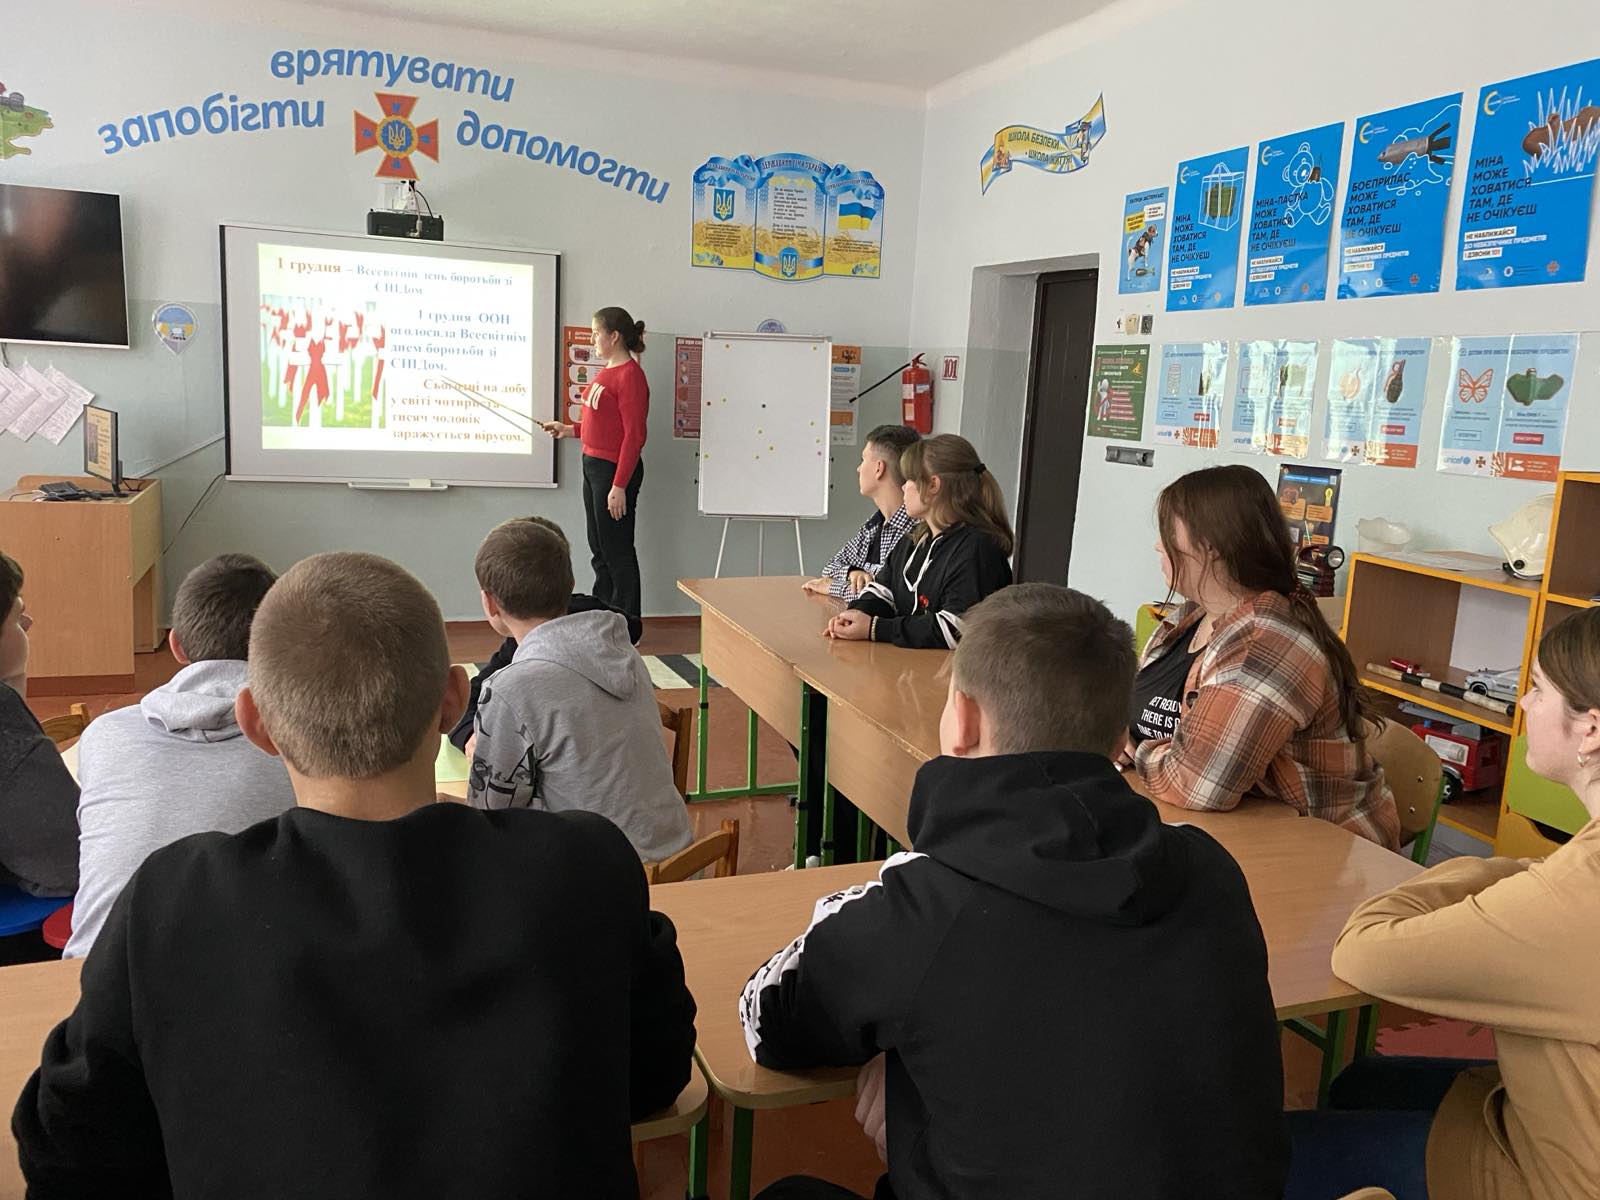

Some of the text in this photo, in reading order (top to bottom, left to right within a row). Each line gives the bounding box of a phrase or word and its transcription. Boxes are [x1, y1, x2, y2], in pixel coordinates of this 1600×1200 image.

[270, 49, 514, 102] врятувати
[98, 92, 325, 155] запобігти
[1008, 131, 1060, 149] ШКОЛА БЕЗПЕКИ
[457, 109, 670, 204] допомогти
[1475, 155, 1504, 170] МІНА
[1473, 167, 1509, 182] МОЖЕ
[1352, 172, 1411, 192] БОЄПРИПАС
[1471, 177, 1532, 196] ХОВАТИСЯ
[1255, 191, 1309, 209] МІНА-ПАСТКА
[1350, 190, 1378, 203] МОЖЕ
[1469, 194, 1513, 210] ТАМ, ДЕ
[1255, 208, 1277, 219] МОЖЕ
[1348, 199, 1397, 215] ХОВАТИСЯ
[1466, 204, 1537, 224] НЕ ОЧІКУЄШ
[1175, 214, 1191, 223] МІНА
[1253, 216, 1293, 230] ХОВАТИСЯ
[1346, 214, 1381, 227] ТАМ, ДЕ
[1174, 223, 1194, 233] МОЖЕ
[1252, 229, 1280, 241] ТАМ, ДЕ
[1358, 223, 1401, 237] ОЧІКУЄШ
[1173, 231, 1207, 243] ХОВАТИСЯ
[1172, 242, 1196, 253] ТАМ, ДЕ
[1251, 238, 1296, 252] НЕ ОЧІКУЄШ
[1171, 251, 1210, 263] НЕ ОЧІКУЄШ
[290, 260, 341, 276] грудня
[450, 272, 501, 286] боротьби
[428, 313, 471, 325] грудня
[478, 313, 510, 325] ООН
[390, 327, 527, 343] оголосила Всесвітнім
[390, 344, 422, 353] днем
[426, 343, 484, 357] боротьби
[944, 358, 958, 379] 101
[483, 384, 498, 393] на
[501, 384, 528, 396] добу
[401, 393, 431, 406] світі
[1444, 455, 1463, 465] unicef
[1141, 708, 1164, 726] THERE
[1164, 716, 1173, 728] IS
